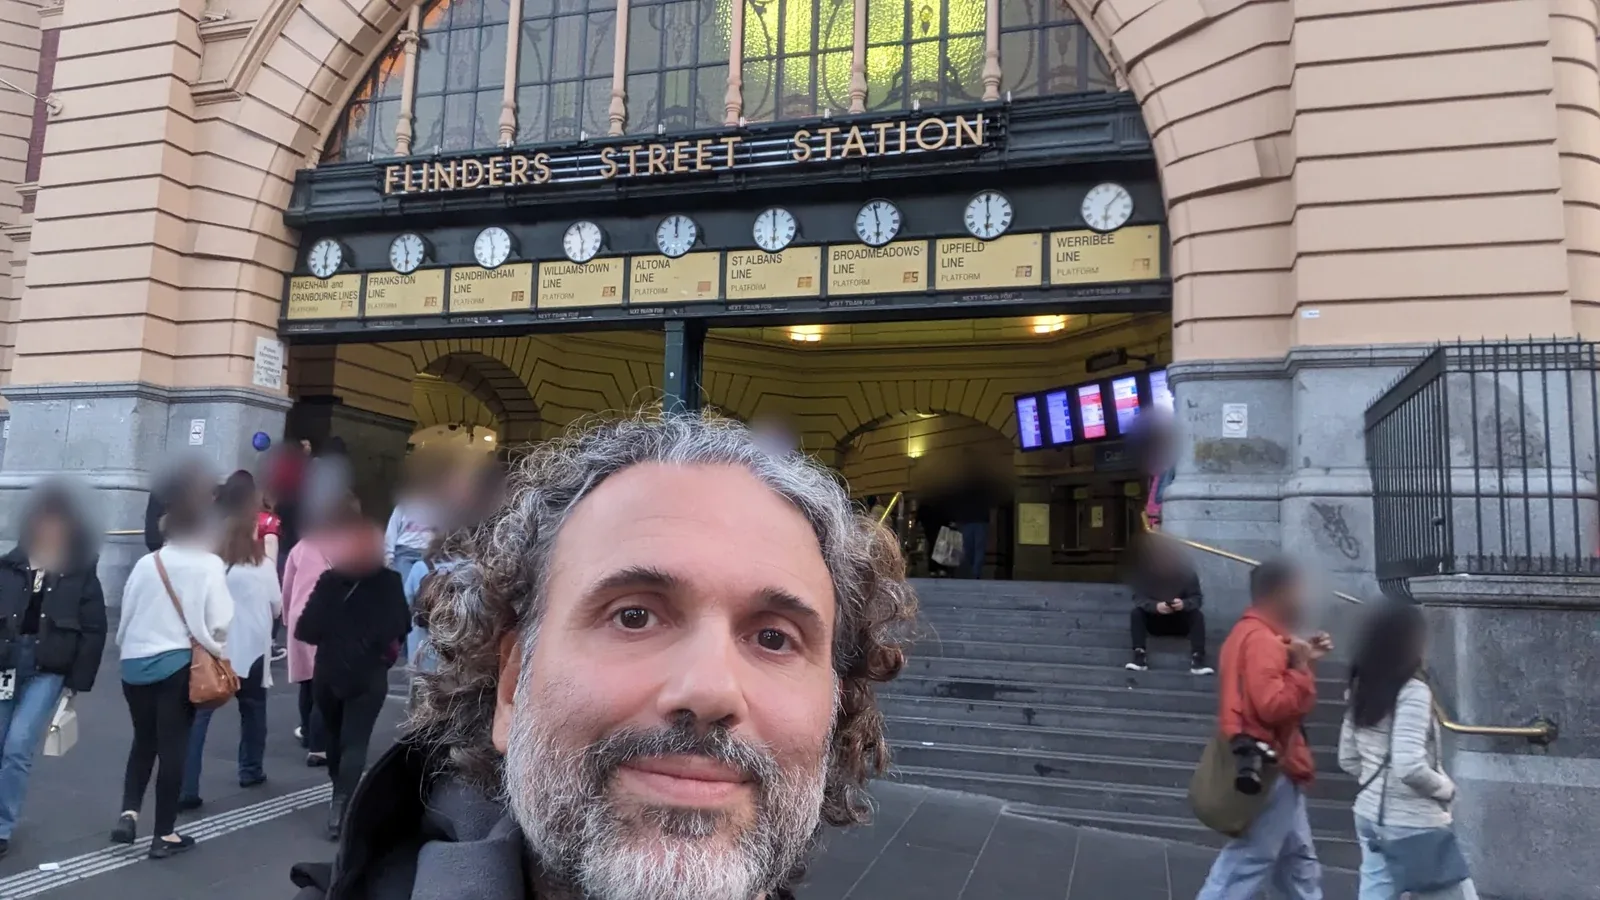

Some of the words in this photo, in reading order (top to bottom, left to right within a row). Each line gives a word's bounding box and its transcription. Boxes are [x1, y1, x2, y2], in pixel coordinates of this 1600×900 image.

[384, 153, 551, 193] FLINDERS
[600, 137, 741, 178] STREET
[792, 113, 983, 162] STATION
[1056, 234, 1115, 248] WERRIBEE
[833, 245, 920, 261] BROADMEADOWS
[942, 242, 985, 254] UPFIELD
[732, 255, 744, 266] ST
[745, 253, 783, 265] ALBANS
[941, 257, 964, 268] LINE
[1056, 251, 1080, 263] LINE
[544, 263, 610, 276] WILLIAMSTOWN
[636, 259, 671, 270] ALTONA
[833, 263, 855, 274] LINE
[454, 269, 515, 281] SANDRINGHAM
[634, 273, 654, 283] LINE
[731, 268, 752, 279] LINE
[941, 273, 981, 282] PLATFORM
[292, 281, 328, 290] PAKENHAM
[331, 280, 343, 289] and
[369, 276, 416, 286] FRANKSTON
[542, 278, 561, 289] LINE
[832, 279, 870, 287] PLATFORM
[368, 289, 385, 298] LINE
[453, 284, 471, 294] LINE
[291, 291, 337, 302] CRANBOURNE
[338, 290, 358, 300] LINES
